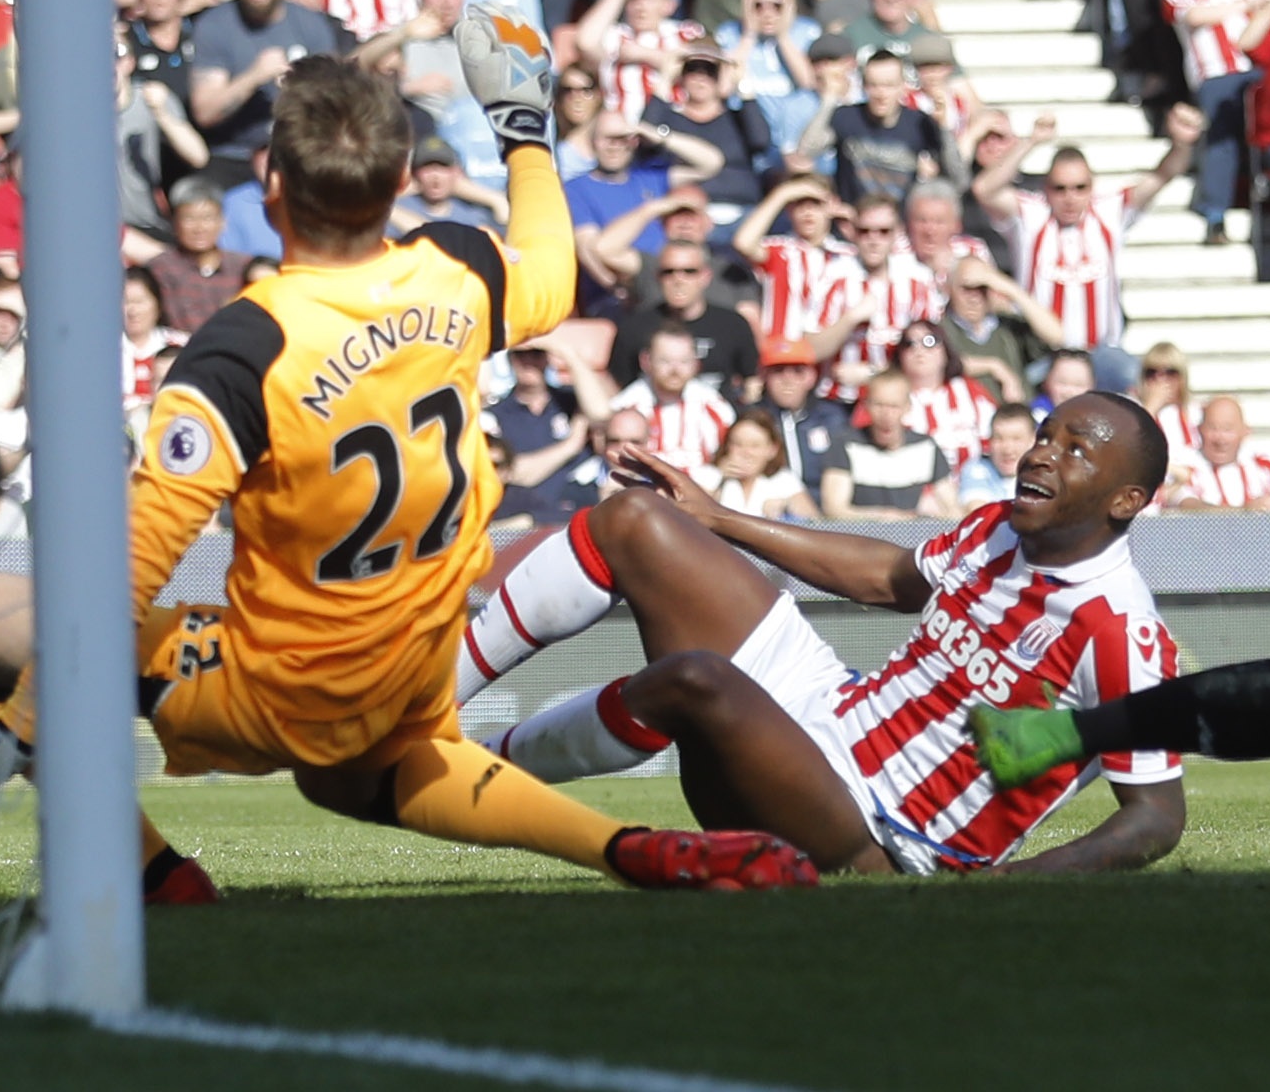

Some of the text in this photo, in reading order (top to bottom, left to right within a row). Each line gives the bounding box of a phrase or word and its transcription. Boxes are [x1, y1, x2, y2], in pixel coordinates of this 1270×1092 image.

[301, 305, 474, 420] MIGNOLET
[314, 383, 469, 585] 22
[921, 584, 1020, 705] bet365
